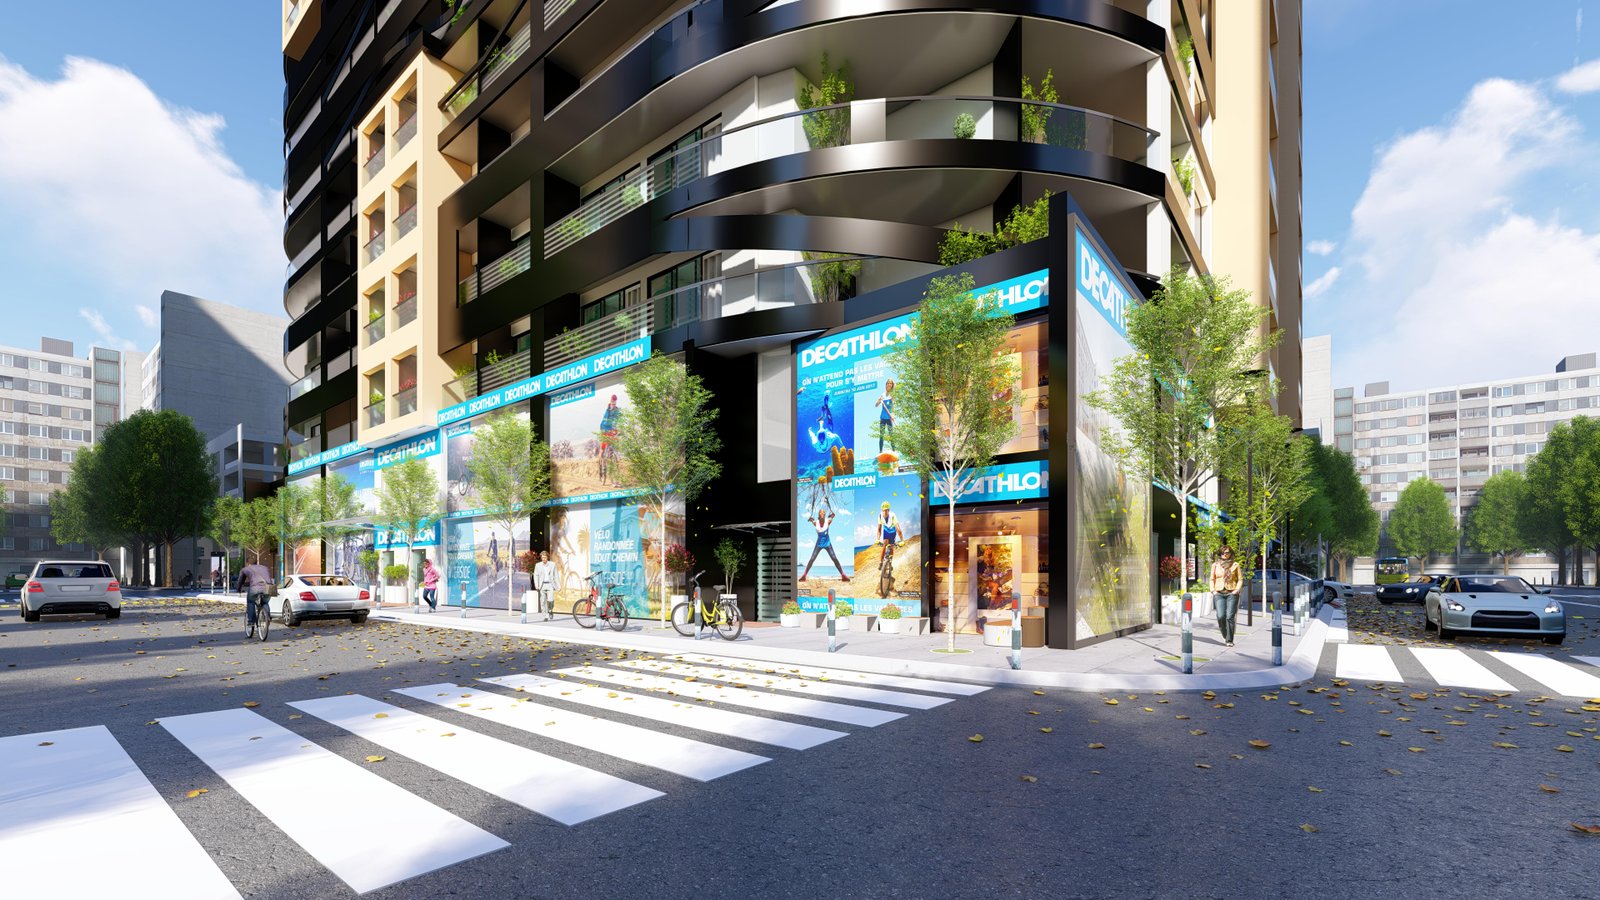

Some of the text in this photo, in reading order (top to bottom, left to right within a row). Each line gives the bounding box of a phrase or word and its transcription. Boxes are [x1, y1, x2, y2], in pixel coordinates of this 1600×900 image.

[439, 344, 644, 424] DECATHLON DECATHLON DECATHLON DECATHLON DECATHLON
[826, 379, 844, 389] POUR
[857, 370, 884, 382] METTRE
[551, 385, 592, 404] DECATHLON
[377, 435, 436, 466] DECATHLON
[834, 475, 876, 489] DECATHLON
[611, 551, 639, 562] CHEMIN
